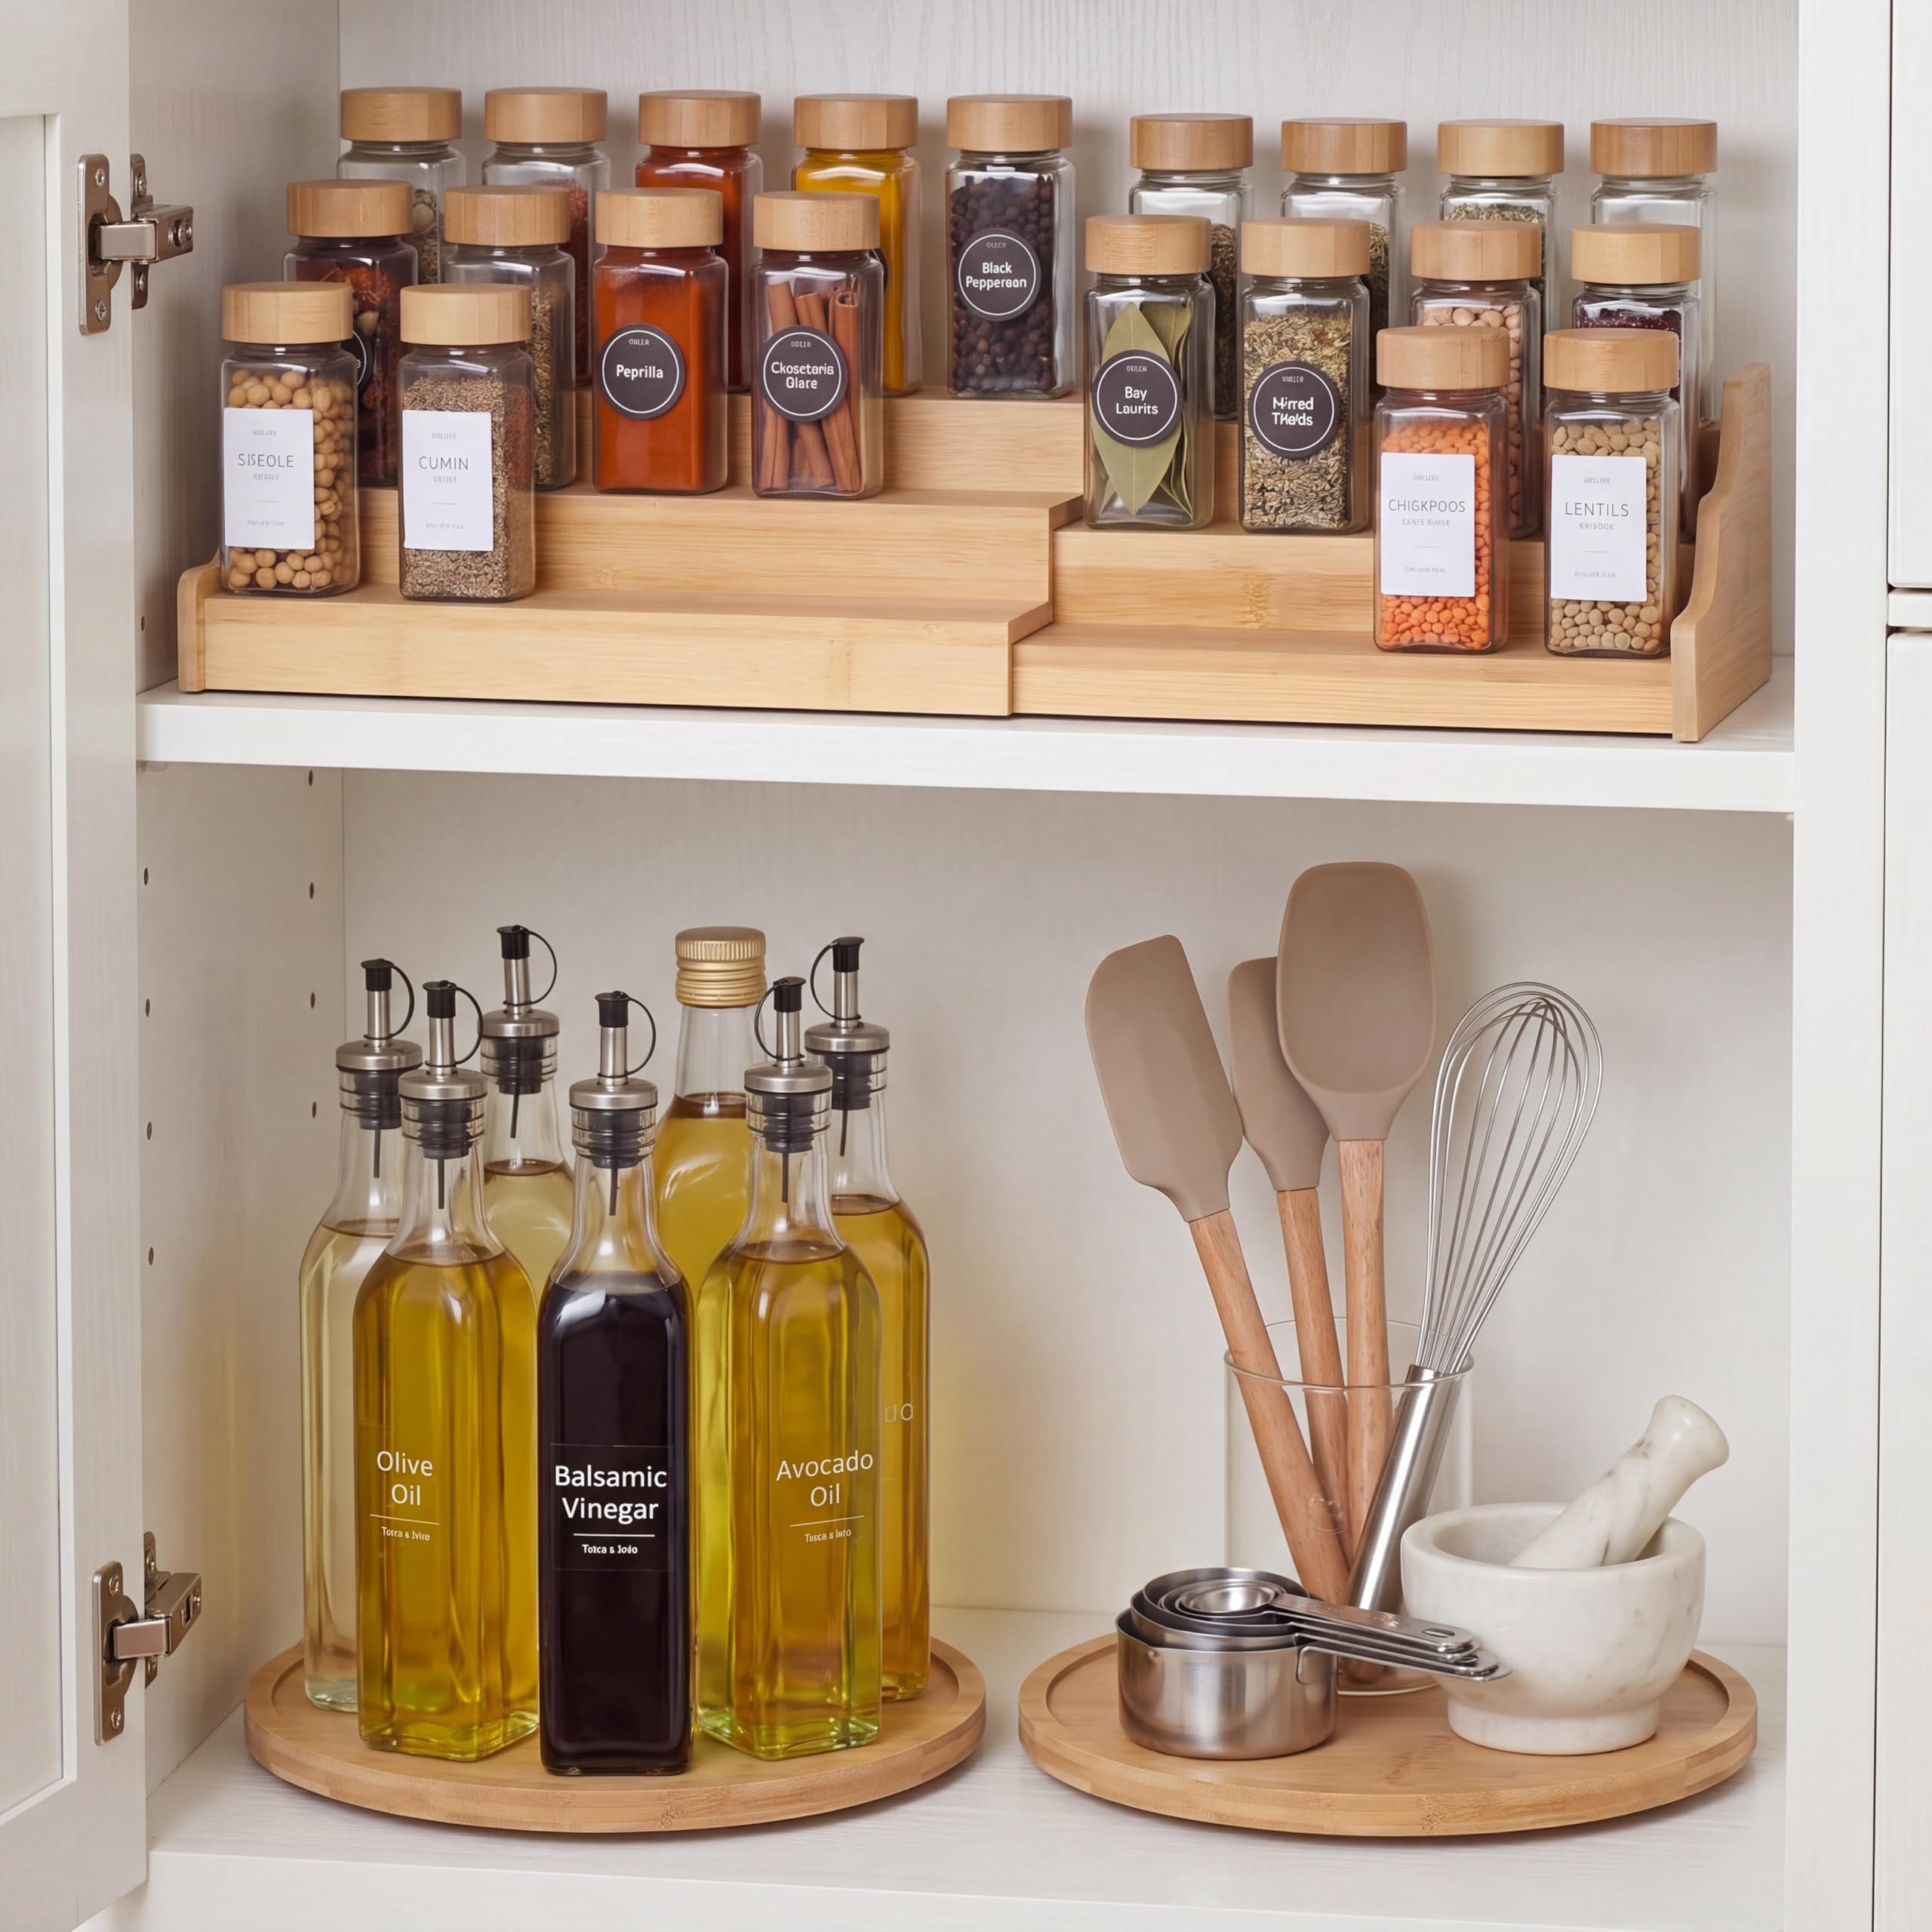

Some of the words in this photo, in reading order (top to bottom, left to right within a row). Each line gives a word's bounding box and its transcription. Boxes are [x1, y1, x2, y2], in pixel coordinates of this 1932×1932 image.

[982, 261, 1013, 274] Black
[616, 364, 664, 381] Peprilla
[1124, 386, 1148, 401] Bay
[1115, 402, 1159, 415] Laurits
[238, 453, 294, 468] SISEOLE
[419, 456, 469, 470] CUMIN
[1565, 502, 1629, 517] LENTILS
[377, 1451, 433, 1477] Olive
[776, 1450, 874, 1481] Avocado
[555, 1464, 668, 1488] Balsamic
[391, 1484, 420, 1506] Oil
[810, 1483, 841, 1507] Oil
[561, 1497, 660, 1525] Vinegar
